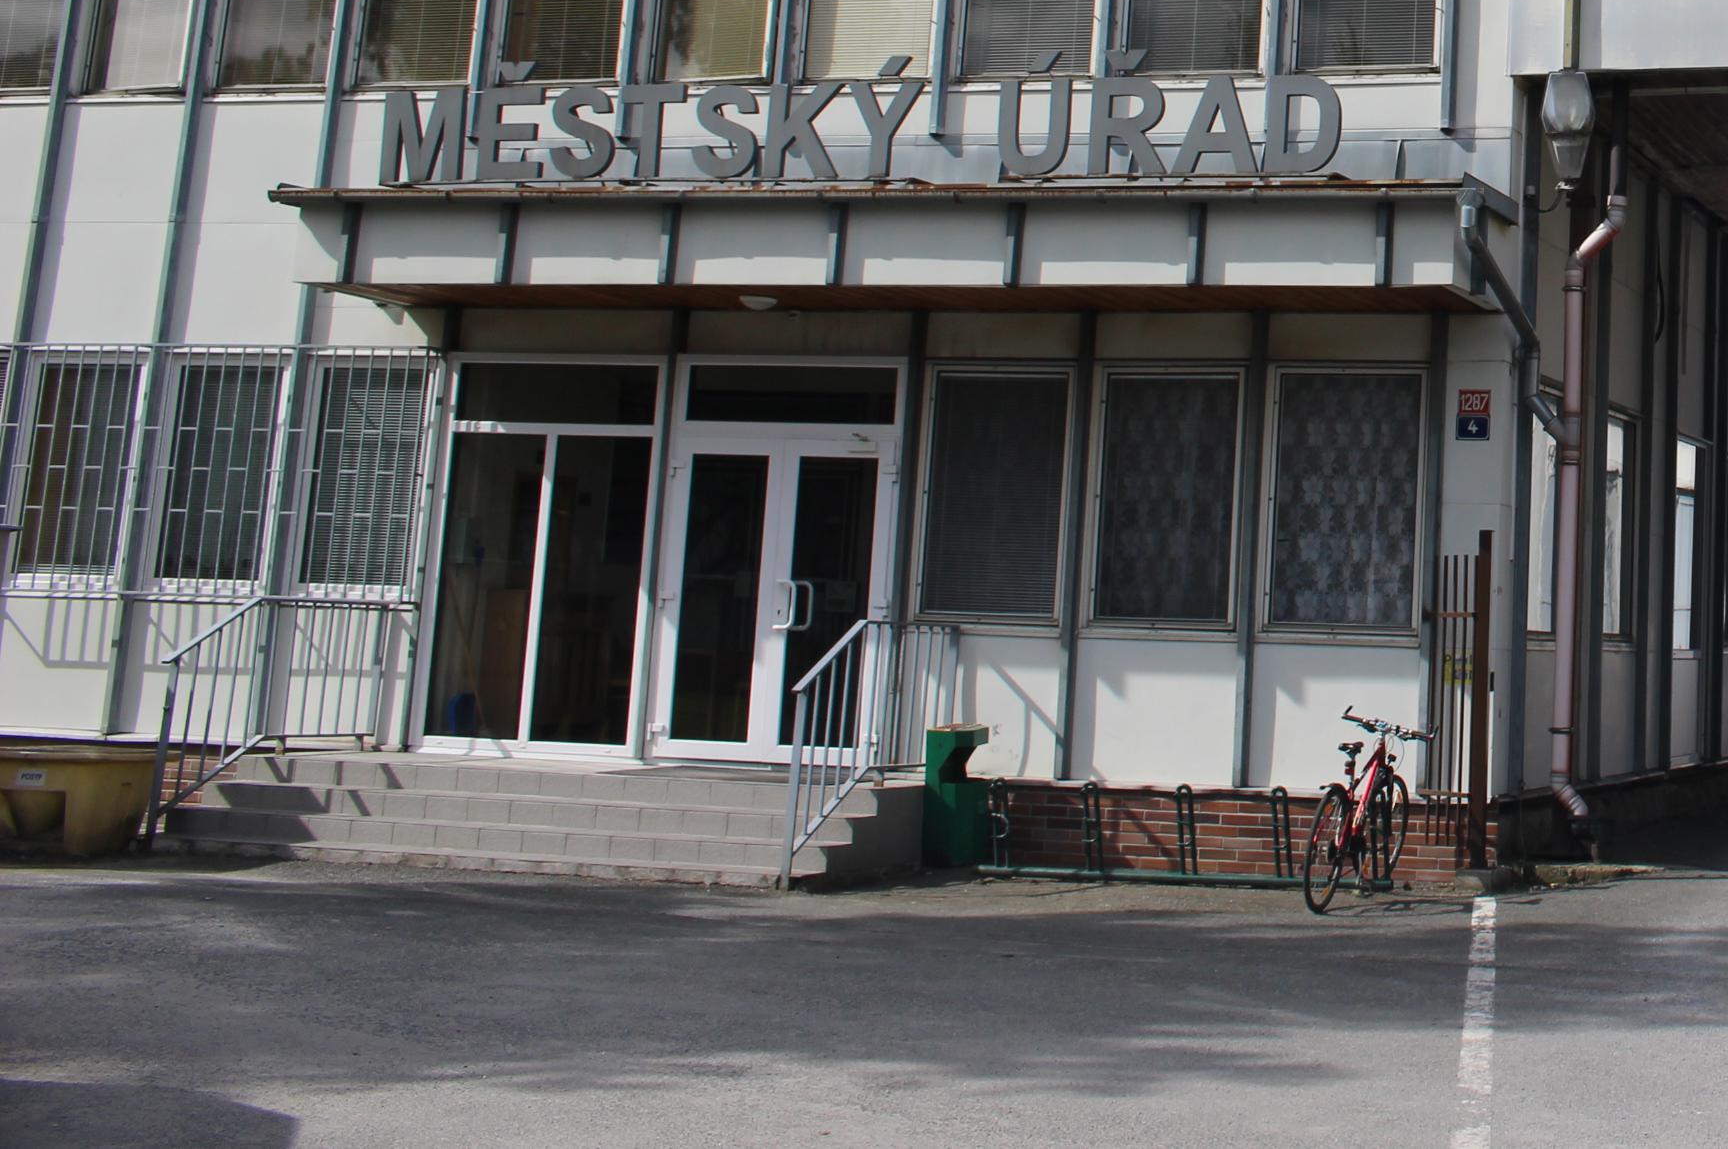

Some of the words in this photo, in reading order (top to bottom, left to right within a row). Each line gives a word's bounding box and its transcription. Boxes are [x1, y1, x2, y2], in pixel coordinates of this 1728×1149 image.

[379, 55, 926, 185] MĚSTSKÝ
[1000, 50, 1343, 179] ÚŘAD
[1460, 393, 1489, 411] 1287
[1467, 419, 1478, 434] 4
